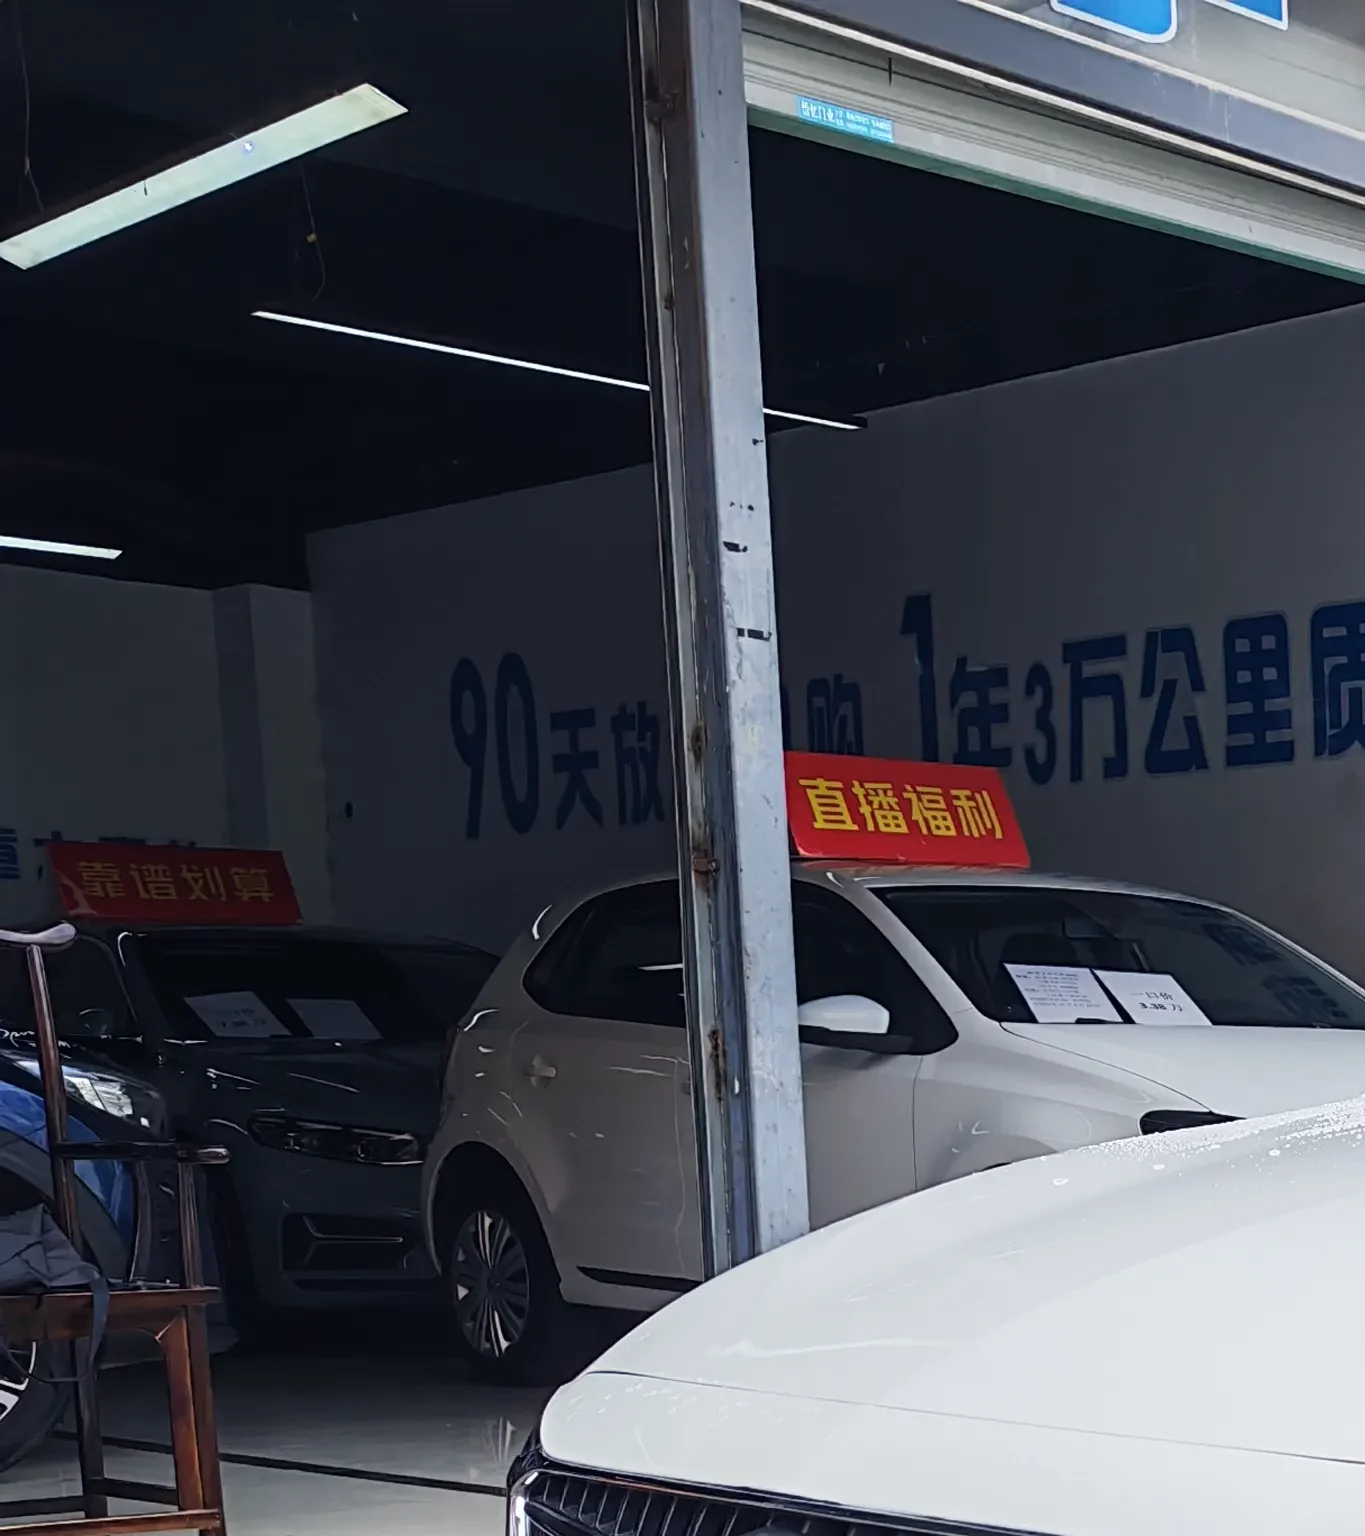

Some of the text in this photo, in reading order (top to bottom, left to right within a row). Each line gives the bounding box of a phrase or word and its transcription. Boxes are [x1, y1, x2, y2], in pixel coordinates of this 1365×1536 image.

[799, 777, 1004, 841] 直播福利
[77, 861, 275, 902] 靠谱划算
